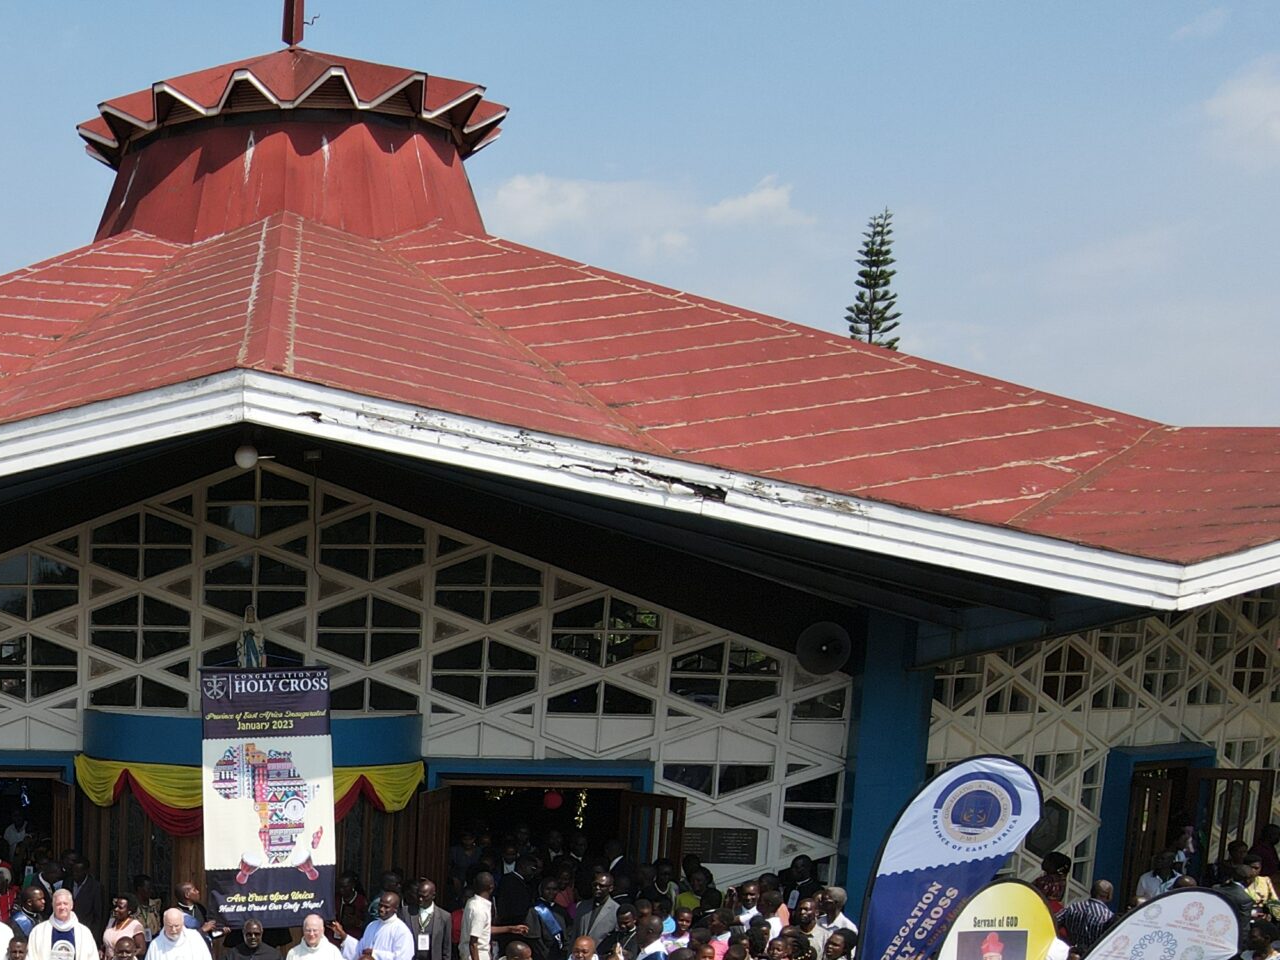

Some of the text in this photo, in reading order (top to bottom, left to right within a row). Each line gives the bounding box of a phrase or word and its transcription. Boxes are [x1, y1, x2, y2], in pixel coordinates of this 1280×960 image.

[234, 671, 311, 679] CONGREGATION
[234, 677, 328, 693] HOLY CROSS
[237, 720, 294, 730] January 2023
[932, 809, 950, 846] PROVINCE
[966, 844, 988, 852] EAST
[992, 820, 1018, 845] AFRICA
[914, 886, 959, 940] CROSS
[973, 916, 1018, 928] Servant of GOD
